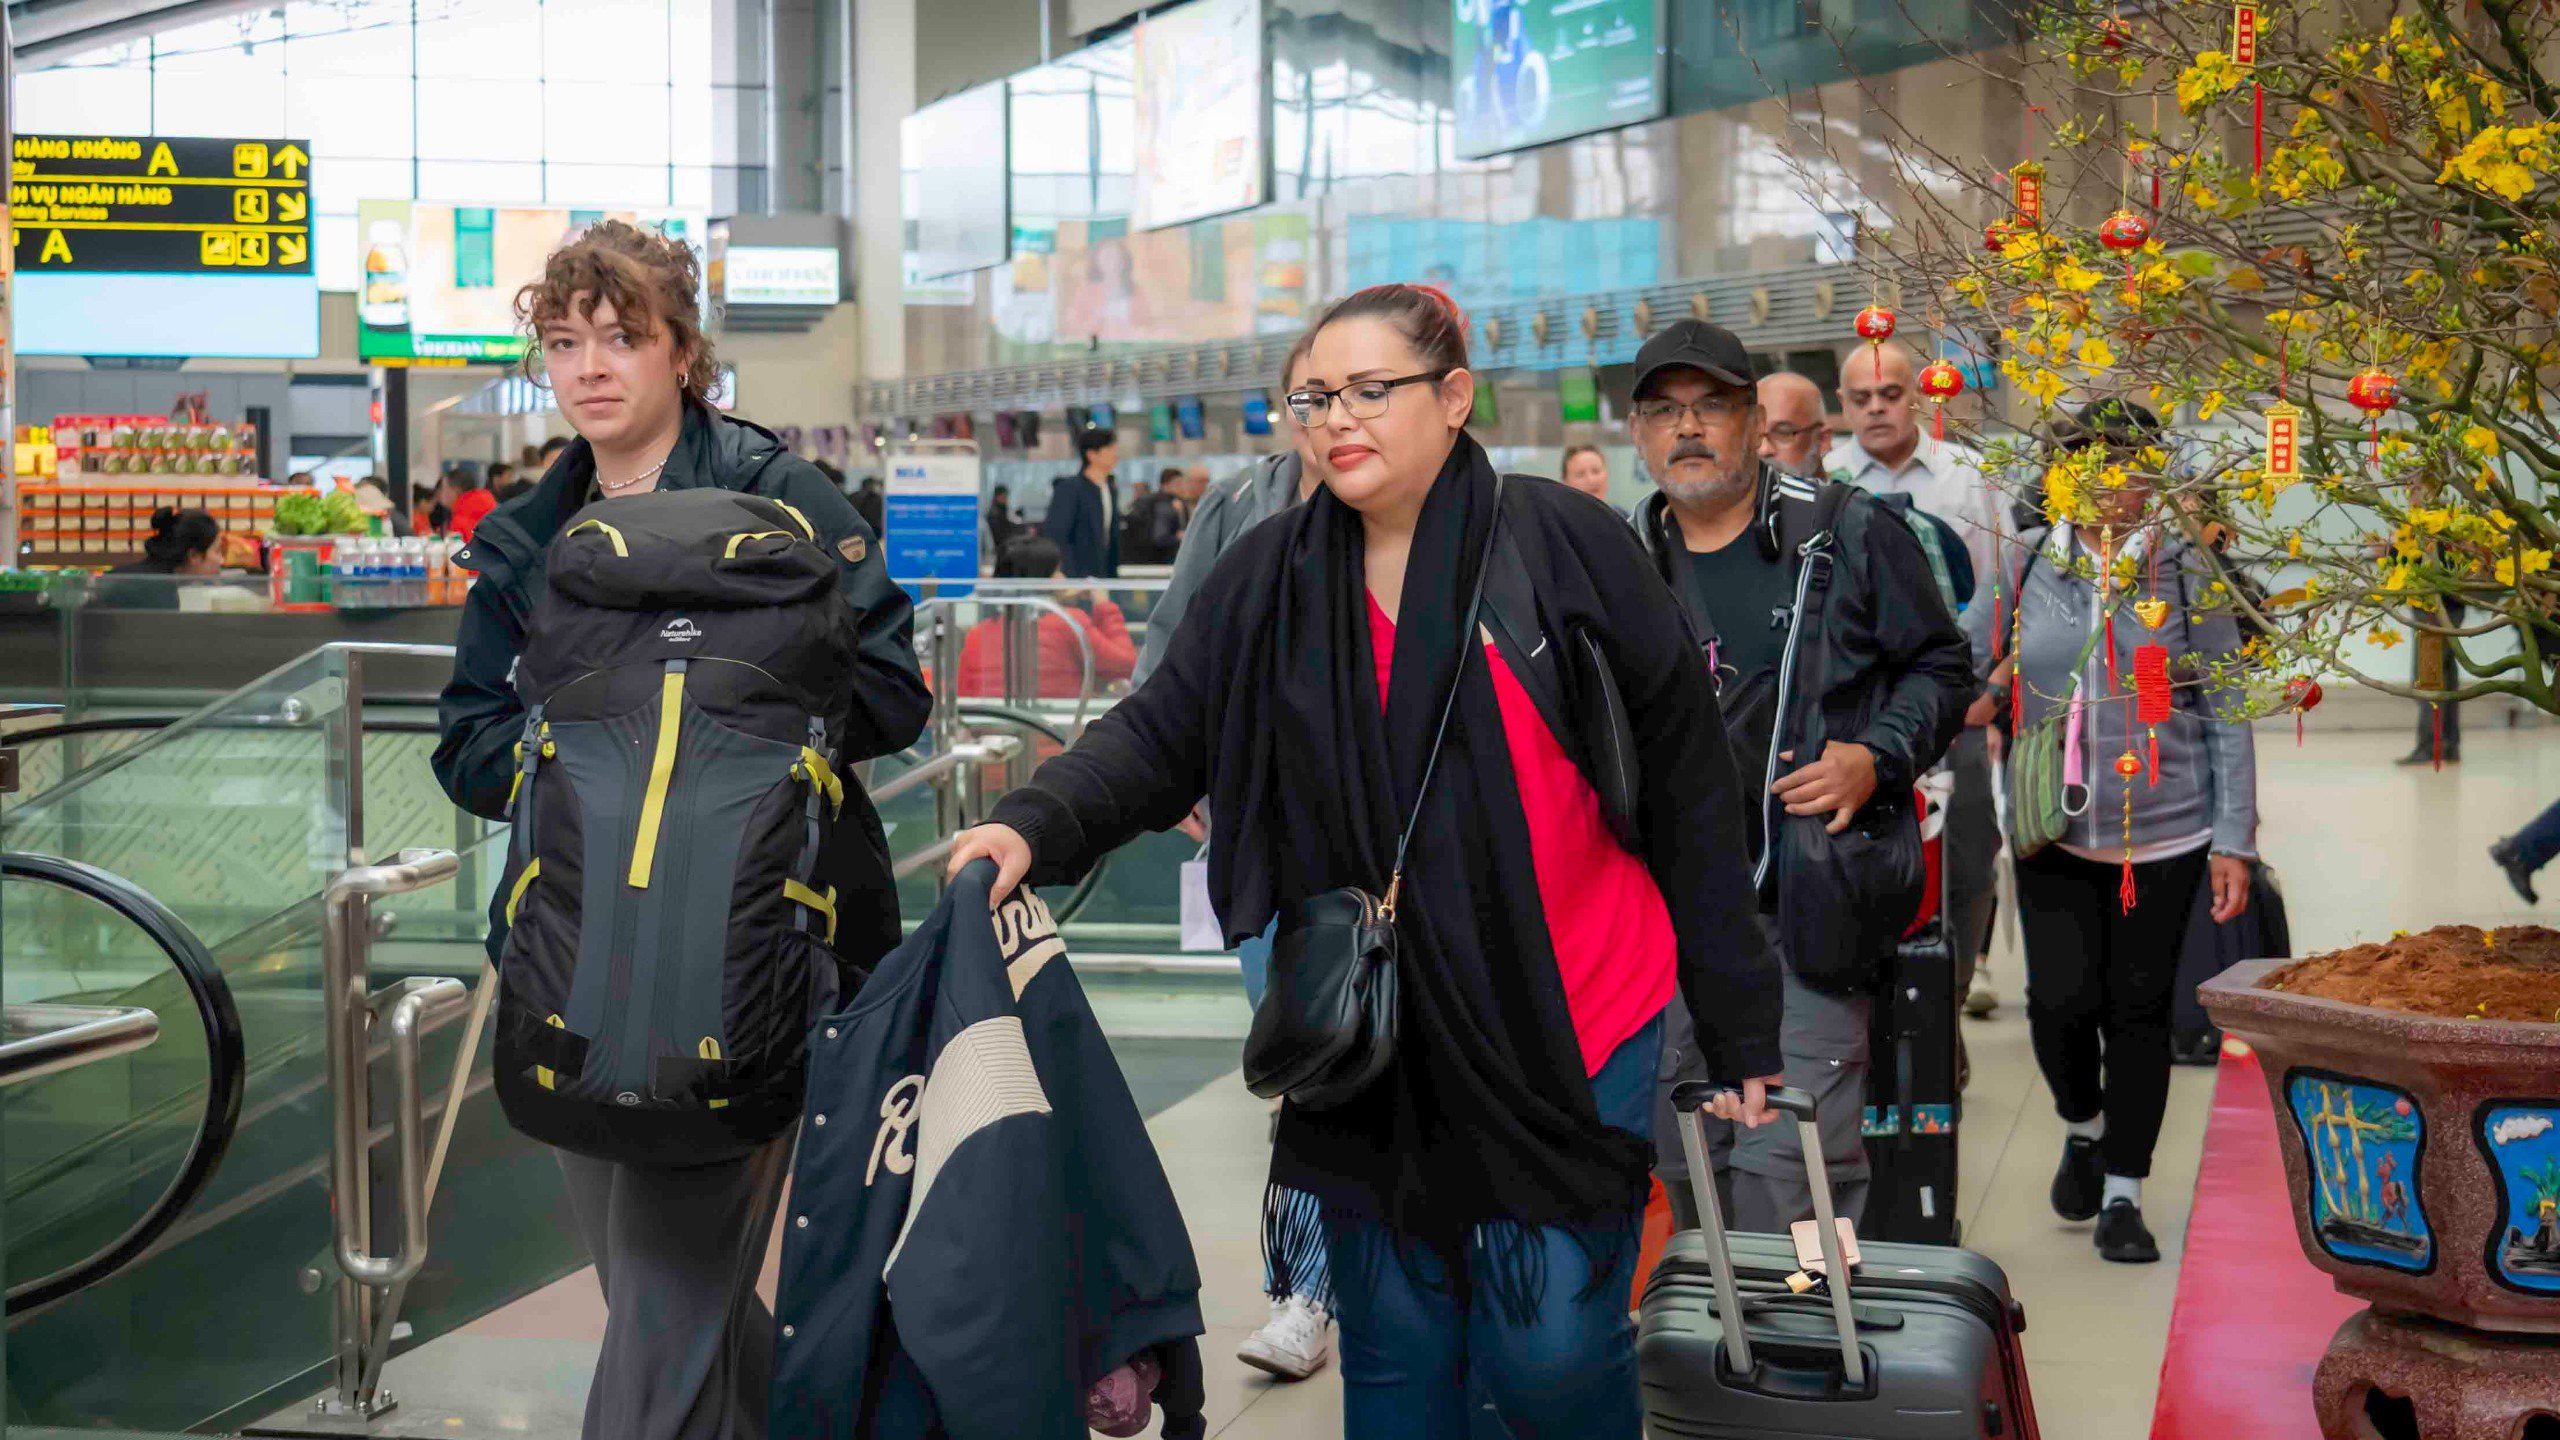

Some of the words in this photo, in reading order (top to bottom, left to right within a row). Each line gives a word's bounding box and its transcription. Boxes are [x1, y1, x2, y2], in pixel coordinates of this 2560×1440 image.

[72, 137, 142, 160] KHÔNG
[147, 141, 180, 176] A
[30, 186, 58, 207] VỤ
[59, 183, 116, 205] NGÂN
[116, 183, 173, 206] HÀNG
[40, 228, 74, 264] A
